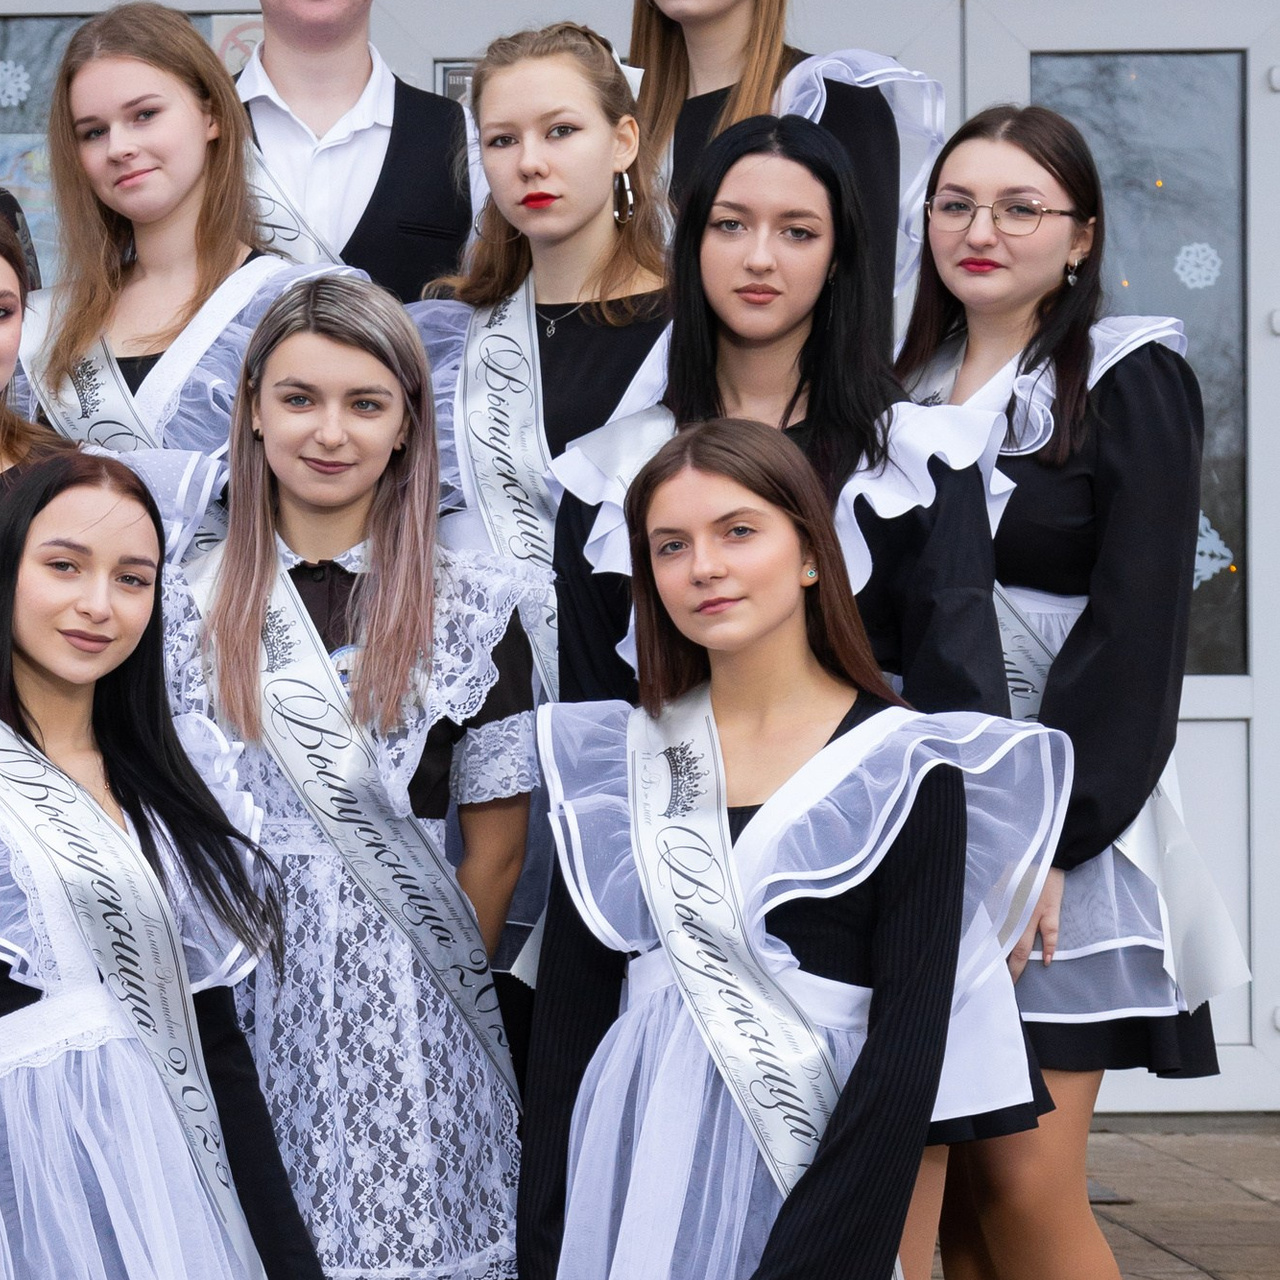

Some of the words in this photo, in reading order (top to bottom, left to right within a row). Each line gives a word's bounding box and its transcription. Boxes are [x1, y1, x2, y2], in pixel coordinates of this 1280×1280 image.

[469, 334, 554, 567] Выпускниц
[264, 681, 456, 947] Выпускница
[384, 815, 423, 868] Елизавета
[422, 872, 473, 942] Владимировна
[407, 927, 432, 954] школа
[147, 967, 178, 1039] Руслановна
[656, 827, 817, 1145] Выпускница
[750, 1107, 772, 1142] школа
